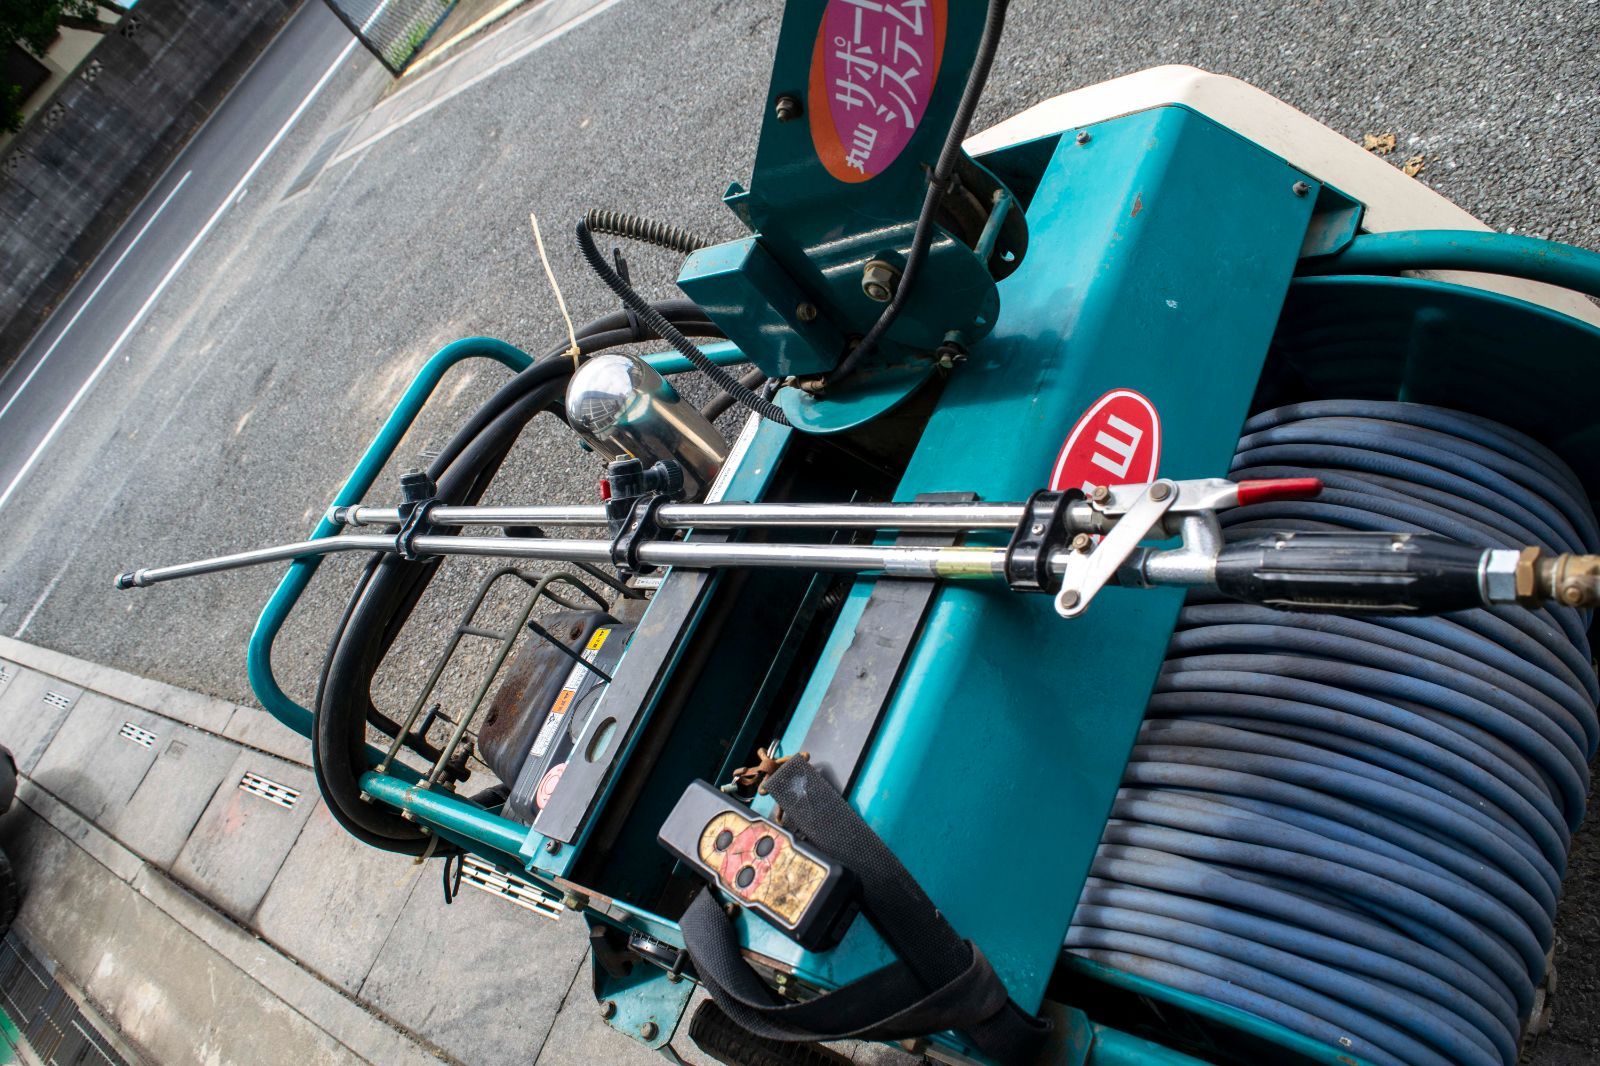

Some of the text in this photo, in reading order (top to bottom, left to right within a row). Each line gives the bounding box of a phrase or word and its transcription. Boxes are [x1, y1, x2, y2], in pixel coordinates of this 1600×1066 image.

[876, 0, 927, 128] システム
[845, 123, 878, 174] 丸山
[1081, 413, 1144, 498] 山
